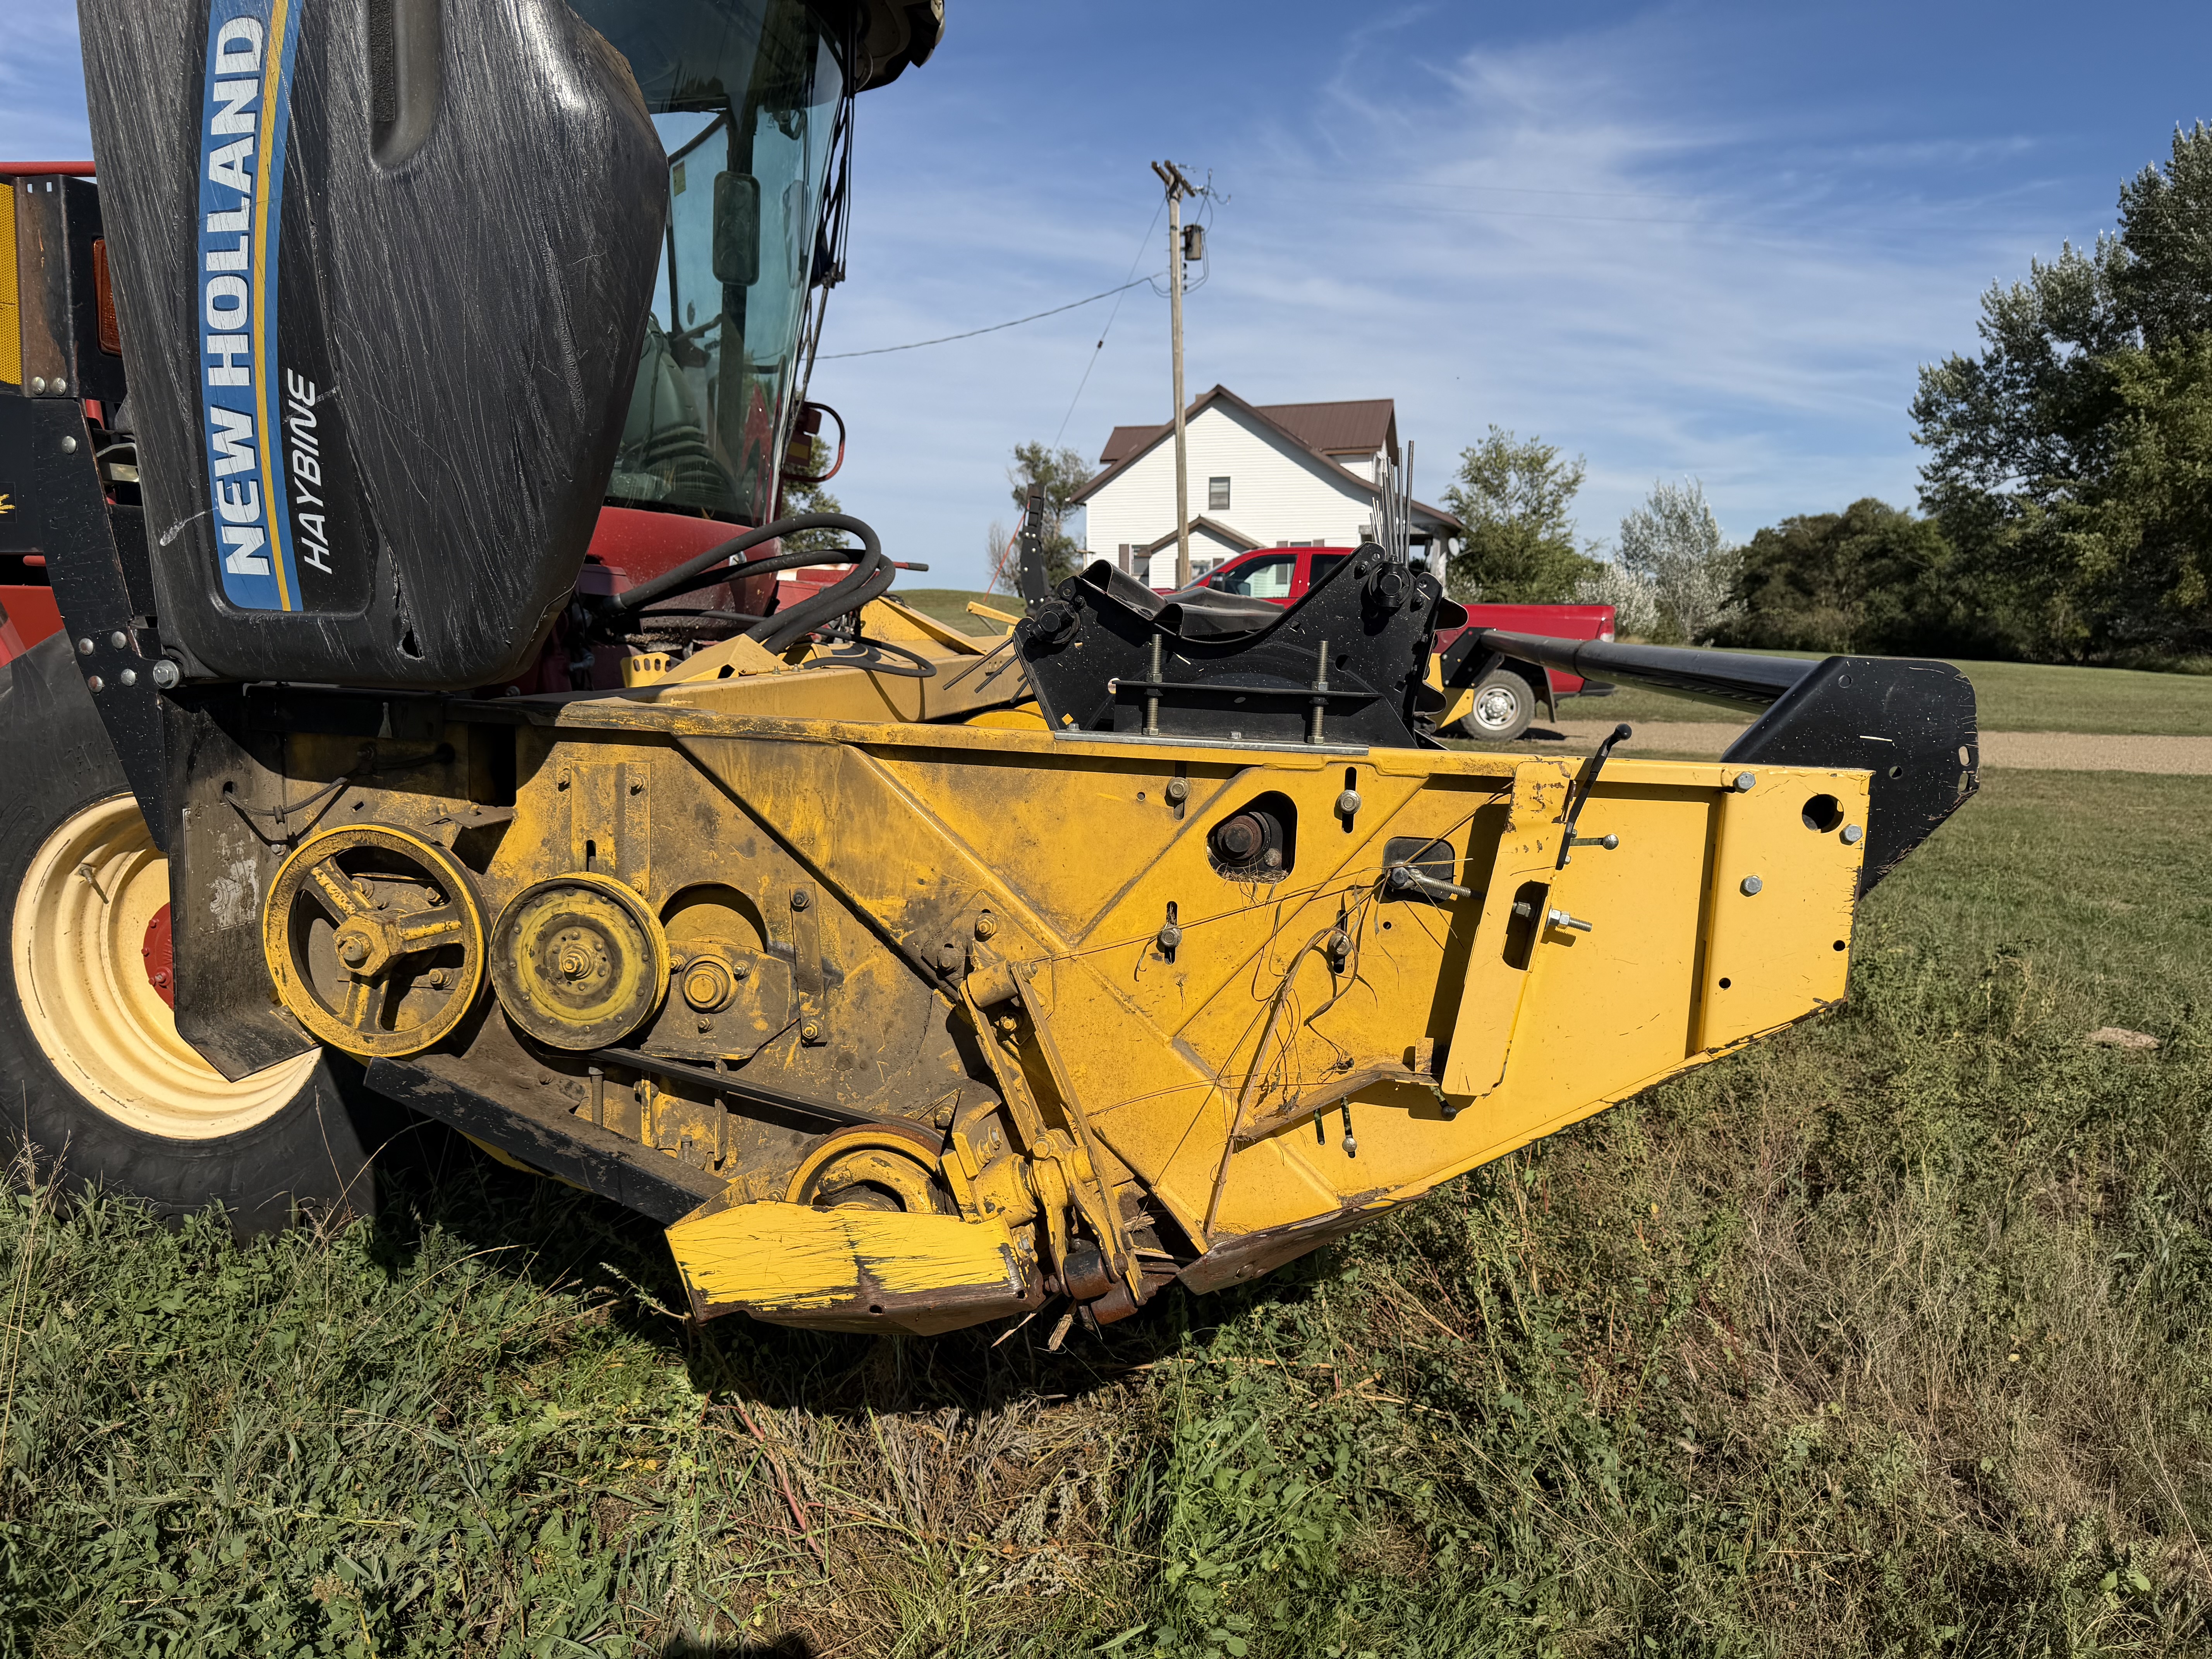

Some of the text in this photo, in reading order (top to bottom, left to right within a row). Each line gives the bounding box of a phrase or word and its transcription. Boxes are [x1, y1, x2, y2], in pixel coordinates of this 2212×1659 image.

[207, 16, 270, 575] NEW HOLLAND
[287, 368, 332, 574] HAYBINE
